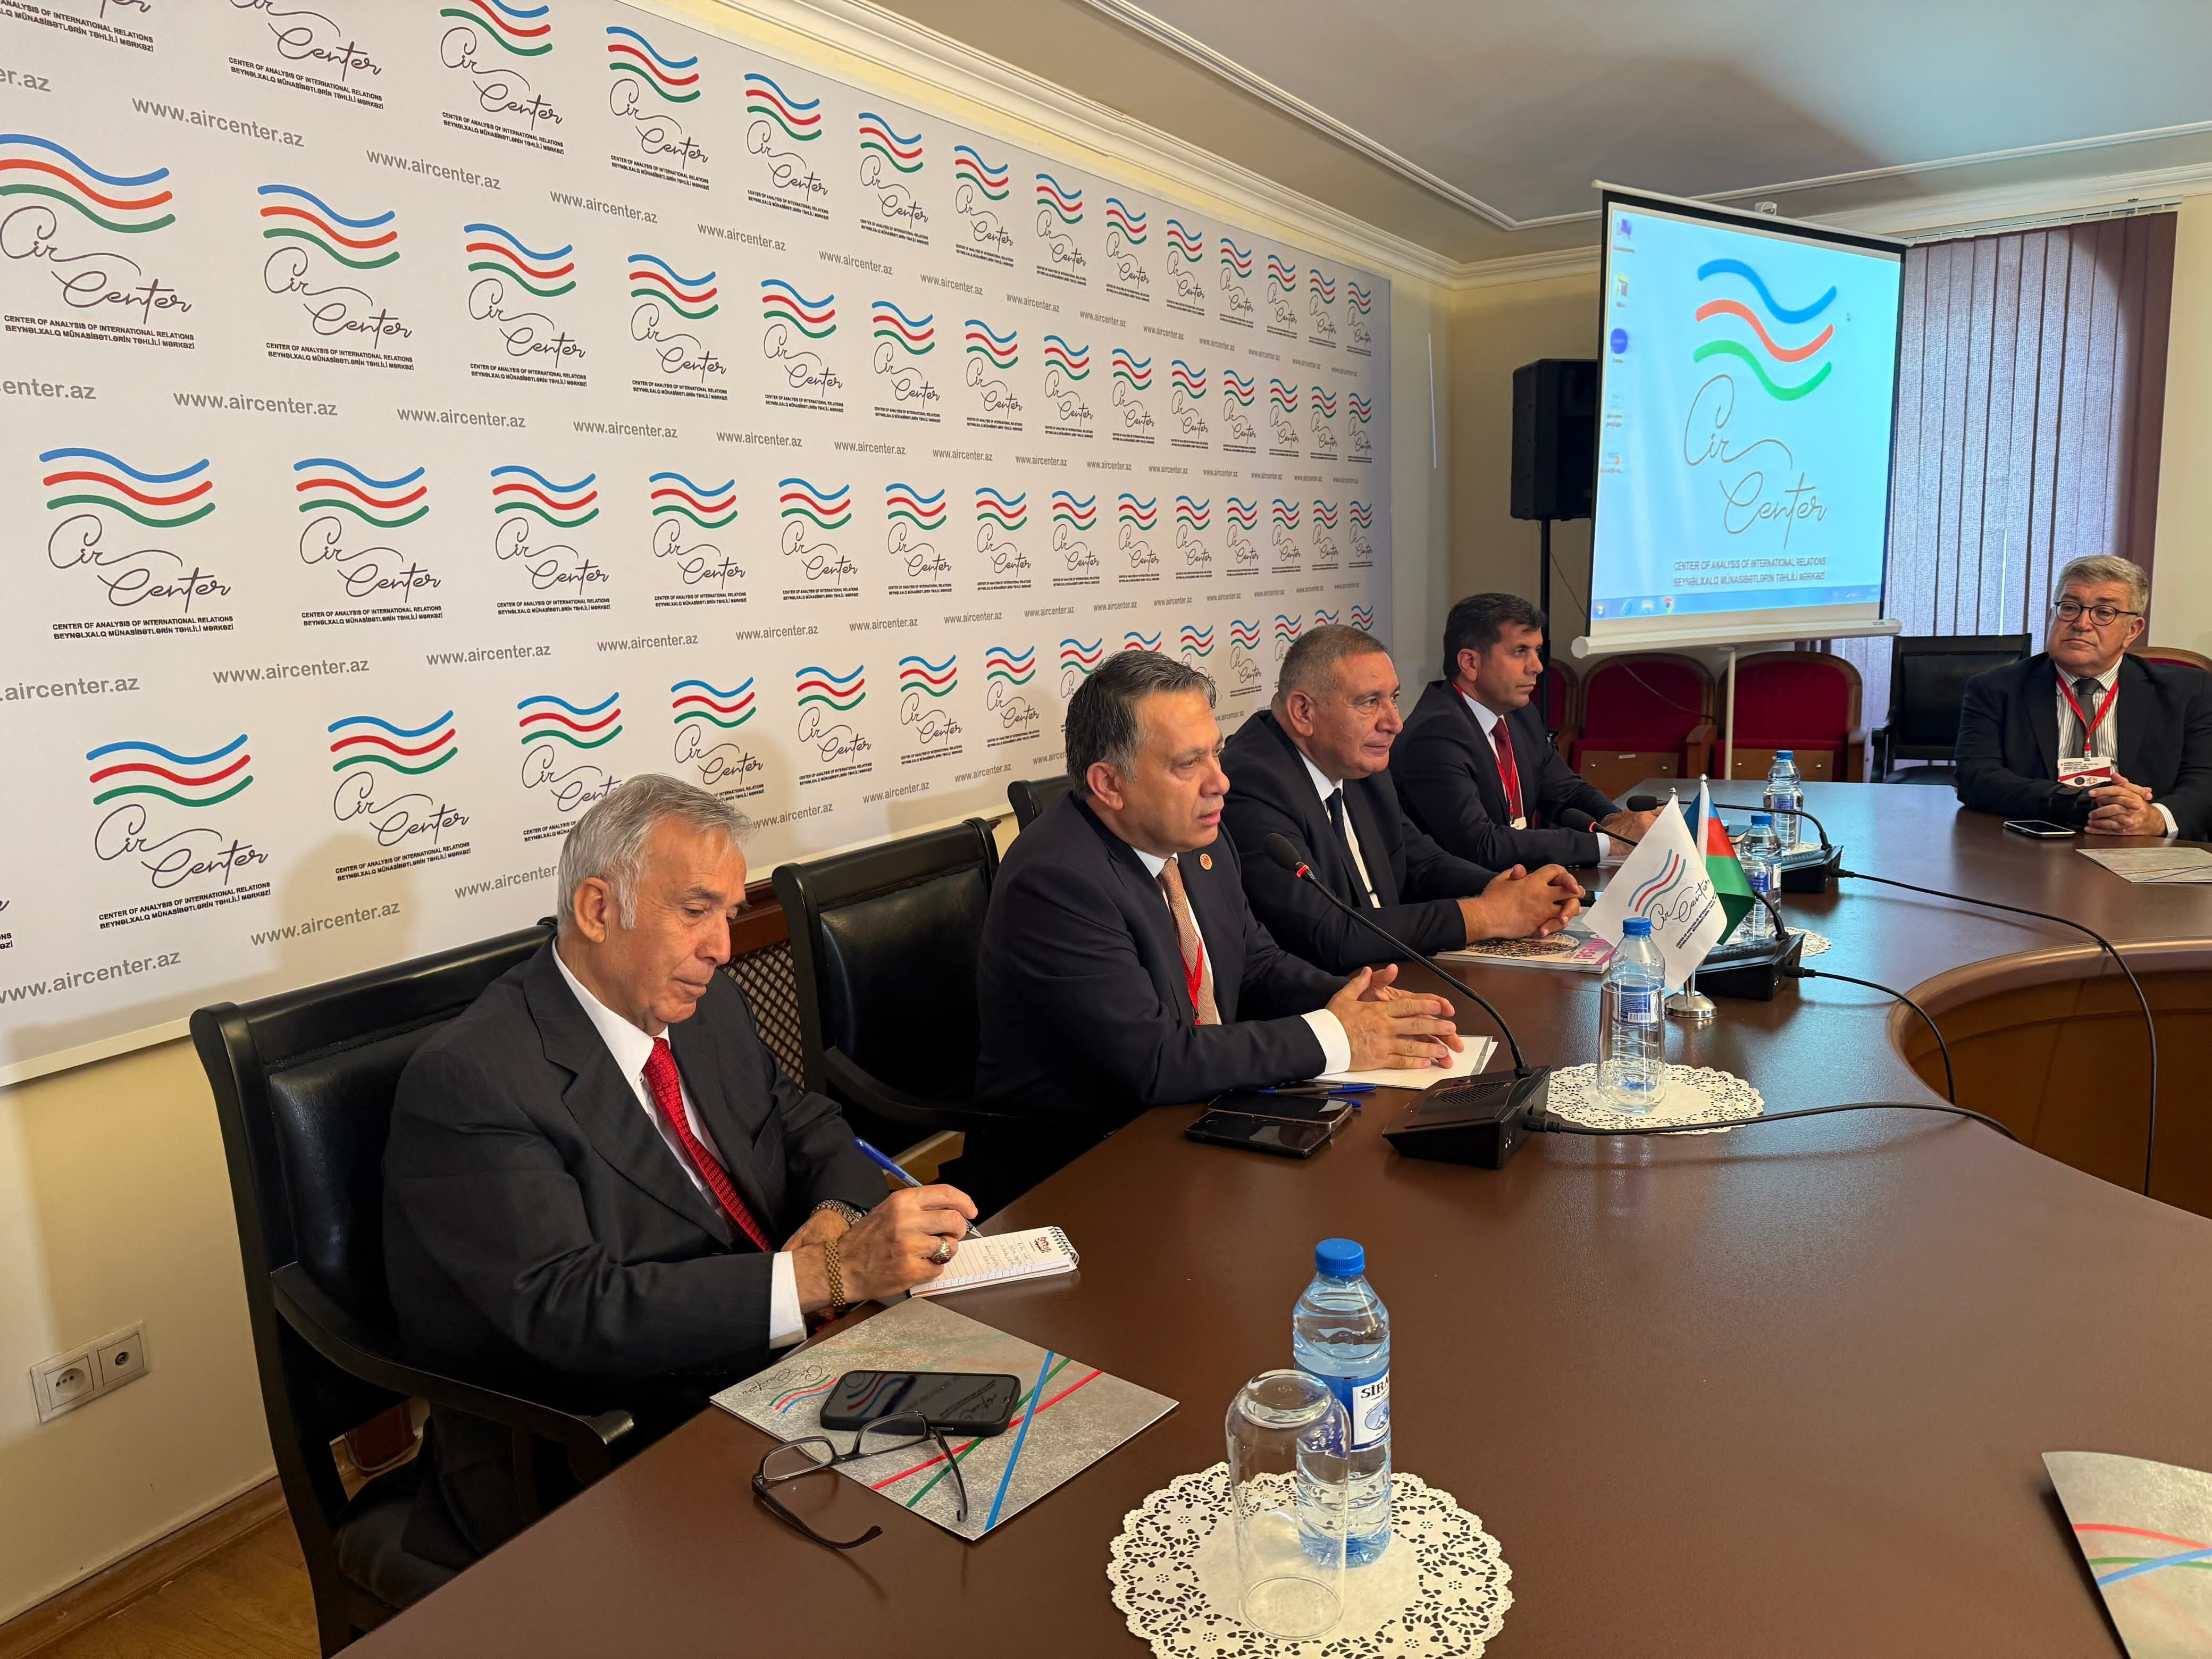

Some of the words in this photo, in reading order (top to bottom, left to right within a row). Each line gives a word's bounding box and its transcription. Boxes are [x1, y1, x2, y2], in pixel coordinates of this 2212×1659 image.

[0, 0, 39, 14] ANALYSIS
[41, 9, 51, 17] OF
[53, 12, 112, 32] INTERNATIONAL
[114, 27, 153, 43] RELATIONS
[268, 22, 381, 82] Center
[229, 57, 254, 69] CENTER
[265, 66, 294, 79] ANALYSIS
[305, 76, 350, 93] INTERNATIONAL
[351, 88, 382, 101] RELATIONS
[473, 80, 562, 131] Center
[132, 98, 304, 147] www.aircenter.az
[635, 125, 708, 170] Center
[366, 150, 501, 190] www.aircenter.az
[768, 162, 828, 202] Center
[550, 191, 658, 224] www.aircenter.az
[877, 193, 928, 229] Center
[698, 223, 786, 251] www.aircenter.az
[819, 251, 893, 275] www.aircenter.az
[1049, 242, 1086, 272] Center
[920, 274, 983, 296] www.aircenter.az
[51, 271, 191, 325] Center
[1006, 294, 1059, 313] www.aircenter.az
[4, 315, 36, 324] CENTER
[49, 320, 86, 329] ANALYSIS
[99, 325, 155, 336] INTERNATIONAL
[156, 331, 194, 340] RELATIONS
[303, 303, 412, 349] Center
[1079, 311, 1126, 328] www.aircenter.az
[1143, 325, 1184, 340] www.aircenter.az
[656, 347, 726, 384] Center
[0, 379, 96, 399] enter.az
[173, 392, 338, 416] www.aircenter.az
[981, 390, 1023, 420] Center
[397, 408, 526, 428] www.aircenter.az
[573, 421, 678, 438] www.aircenter.az
[716, 432, 802, 447] www.aircenter.az
[834, 441, 906, 455] www.aircenter.az
[933, 448, 993, 462] www.aircenter.az
[1015, 455, 1067, 468] www.aircenter.az
[1086, 459, 1132, 471] www.aircenter.az
[1149, 465, 1188, 474] www.aircenter.az
[1720, 471, 1828, 549] Center
[801, 555, 858, 585] Center
[1065, 550, 1100, 575] Center
[525, 559, 609, 596] Center
[97, 567, 231, 614] Center
[1153, 597, 1192, 606] www.aircenter.az
[944, 611, 1002, 625] www.aircenter.az
[1024, 606, 1075, 617] www.aircenter.az
[1093, 601, 1137, 611] www.aircenter.az
[736, 625, 819, 641] www.aircenter.az
[849, 617, 918, 632] www.aircenter.az
[426, 644, 551, 666] www.aircenter.az
[597, 634, 699, 652] www.aircenter.az
[213, 660, 370, 684] www.aircenter.az
[1000, 703, 1040, 730] Center
[817, 733, 872, 764] Center
[954, 764, 1011, 783] www.aircenter.az
[551, 775, 621, 811] Cent
[862, 782, 930, 803] www.aircenter.az
[369, 803, 469, 847] Center
[753, 803, 833, 828] www.aircenter.az
[141, 839, 268, 889] Center
[455, 866, 558, 898] www.aircenter.
[99, 909, 127, 920] CENTER
[139, 901, 172, 912] ANALYSIS
[185, 889, 235, 903] INTERNATIONAL
[236, 882, 270, 893] RELATIONS
[250, 903, 400, 945] www.aircenter.az
